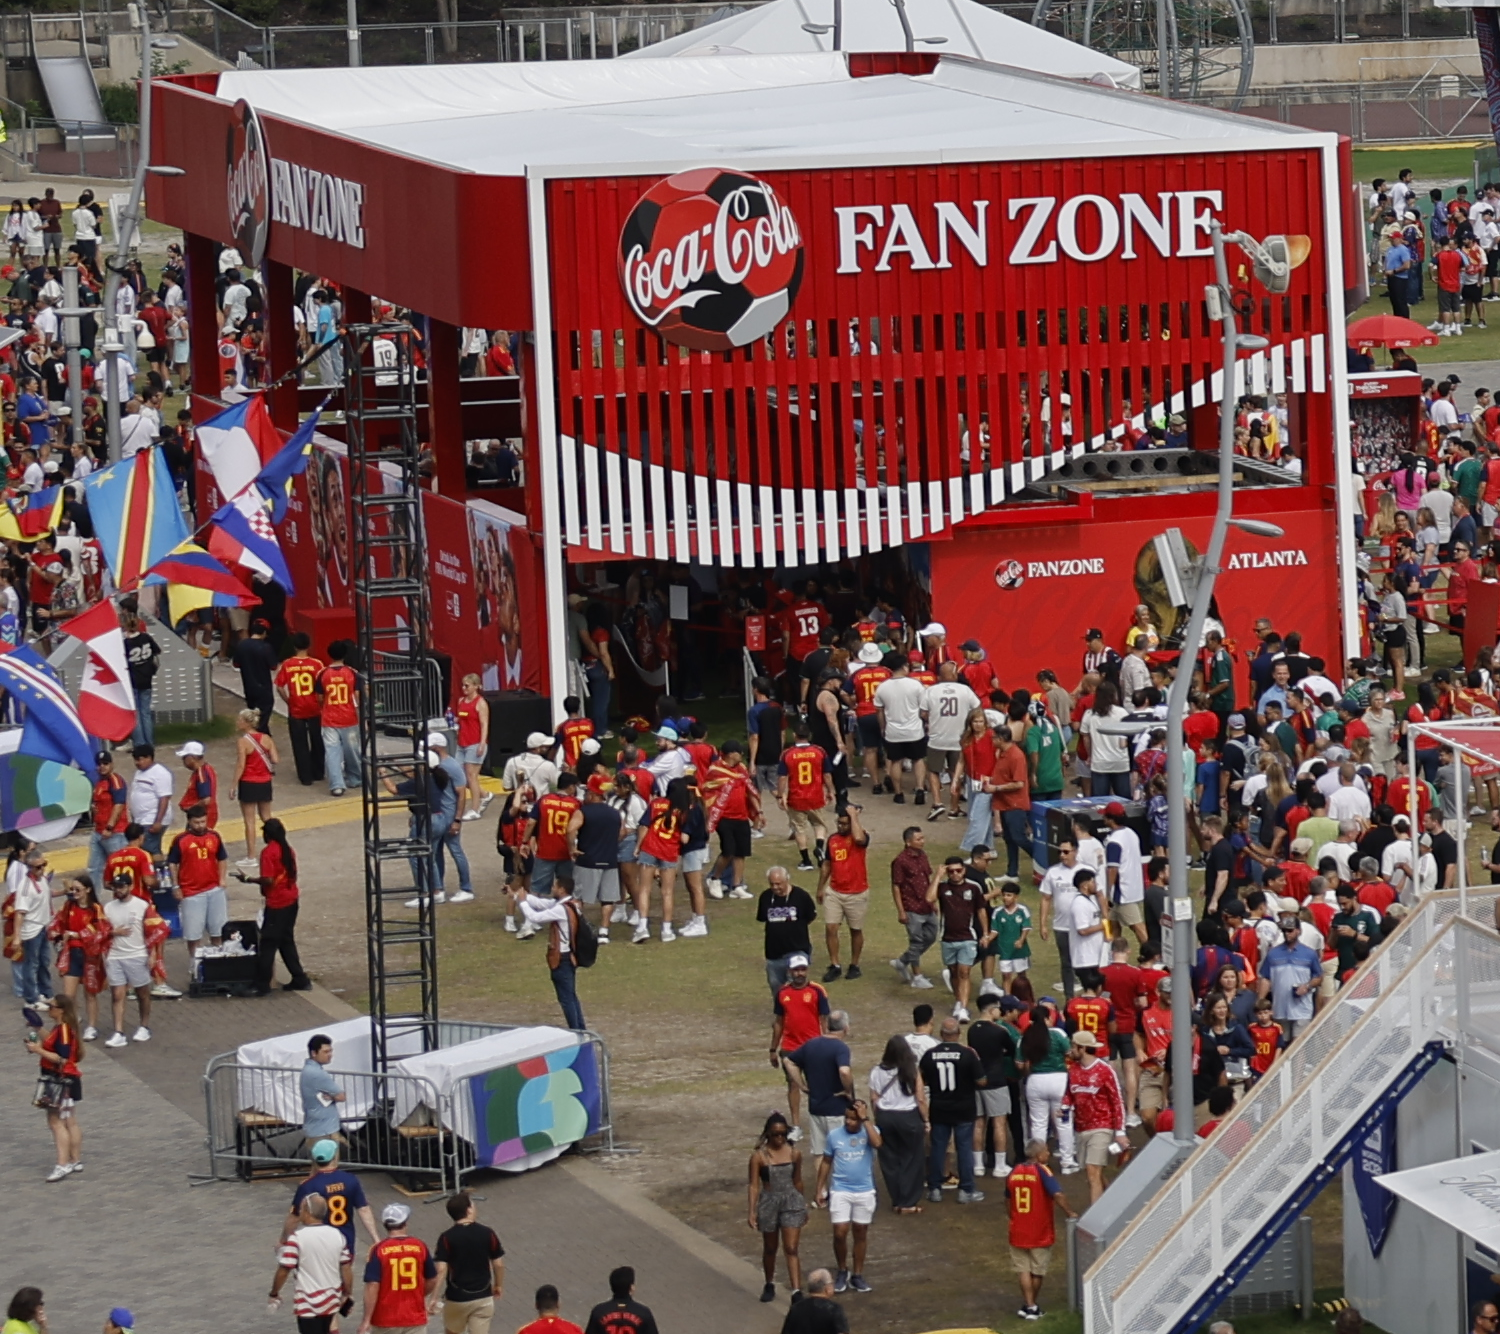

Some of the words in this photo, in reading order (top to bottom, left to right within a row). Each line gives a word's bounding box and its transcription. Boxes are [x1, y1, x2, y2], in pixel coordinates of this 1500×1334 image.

[270, 157, 309, 230] FAN
[308, 170, 365, 249] ZONE
[834, 199, 989, 274] FAN
[1008, 189, 1224, 265] ZONE
[625, 179, 802, 326] Coca-Cola
[1228, 549, 1308, 569] ATLANTA
[328, 1195, 348, 1226] 8
[390, 1257, 418, 1291] 19
